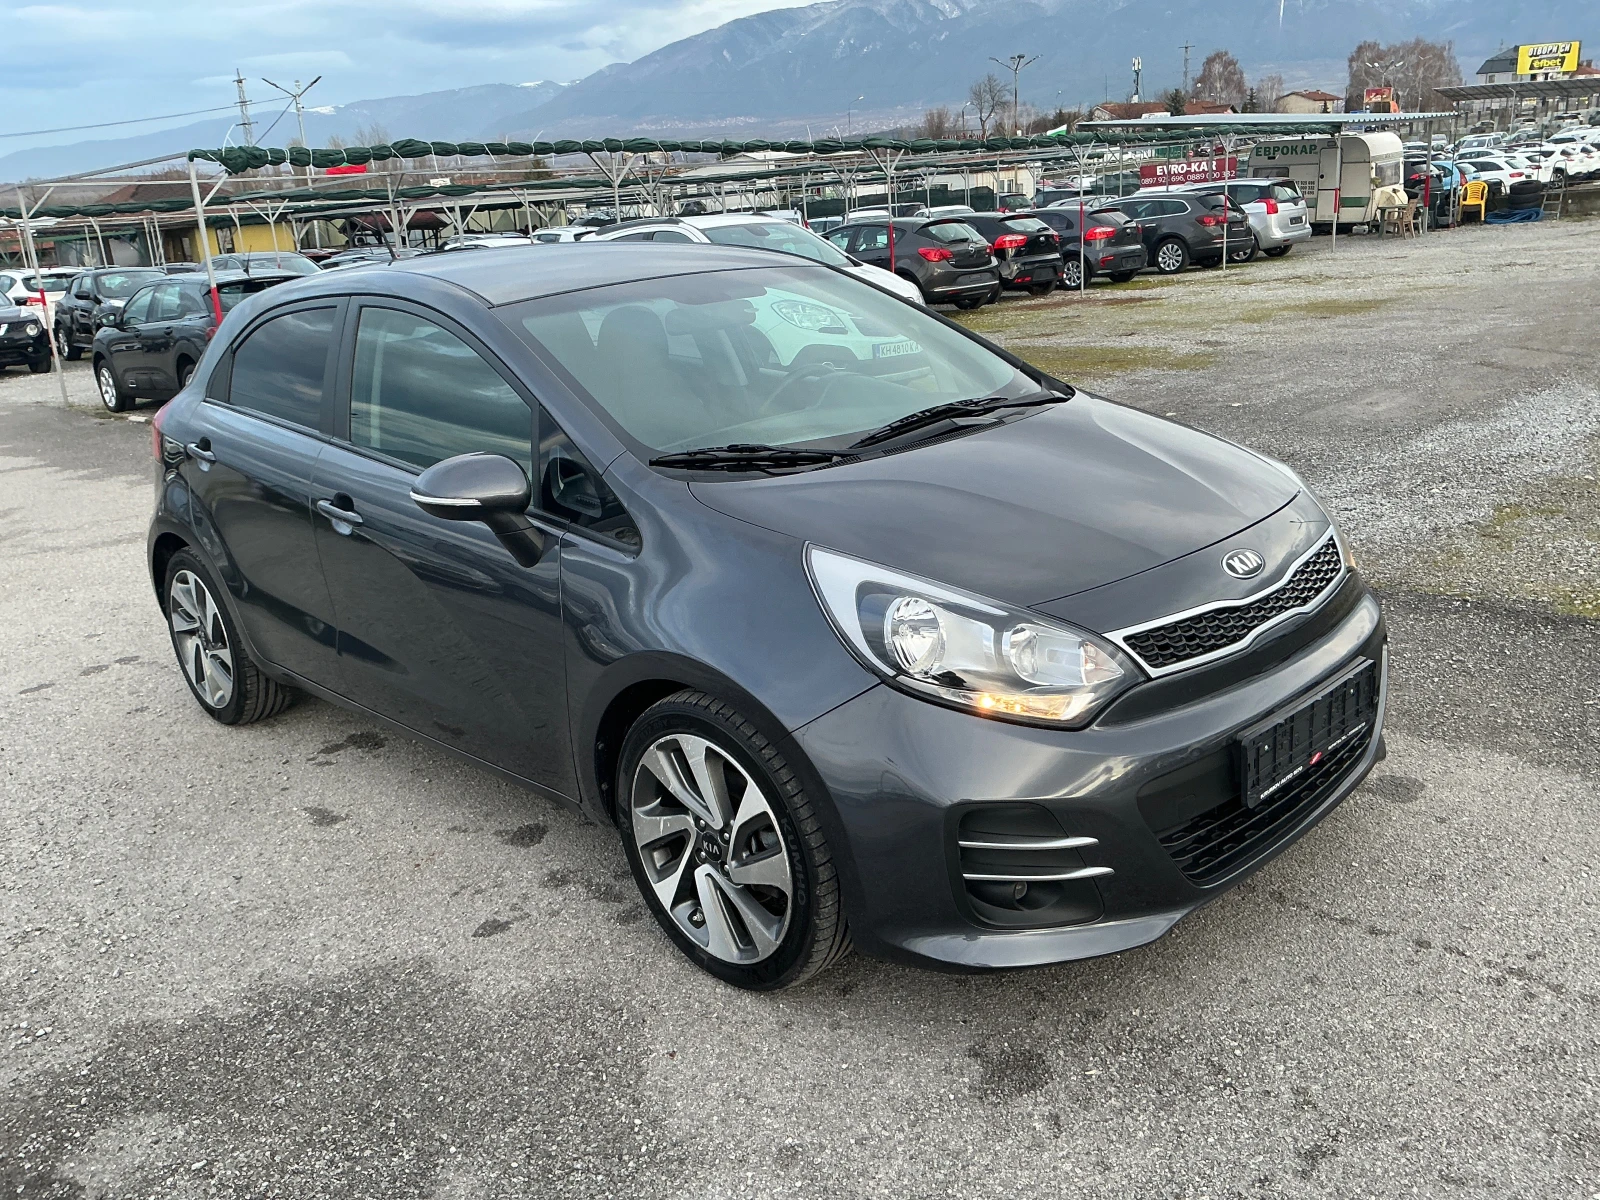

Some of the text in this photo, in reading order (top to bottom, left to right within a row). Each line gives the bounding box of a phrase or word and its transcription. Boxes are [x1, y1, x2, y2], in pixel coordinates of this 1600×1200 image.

[1532, 58, 1562, 68] efbet
[1255, 144, 1317, 156] ЕВРОКАР
[1227, 551, 1262, 574] KIA
[703, 839, 719, 855] KIA
